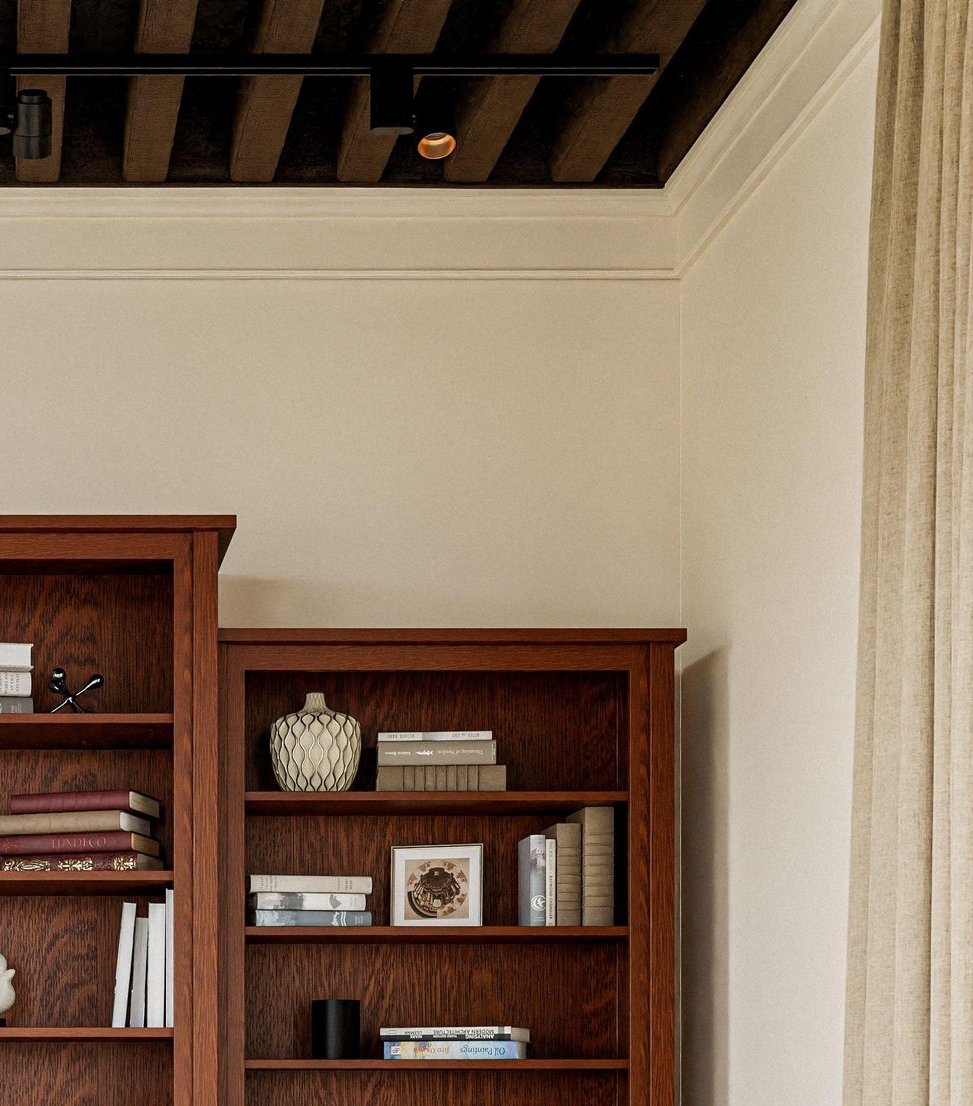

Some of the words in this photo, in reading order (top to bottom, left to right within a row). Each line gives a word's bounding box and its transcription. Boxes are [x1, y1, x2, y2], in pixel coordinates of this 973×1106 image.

[437, 1046, 450, 1055] Jiro
[460, 1045, 493, 1055] Paintings
[494, 1047, 506, 1055] Oil
